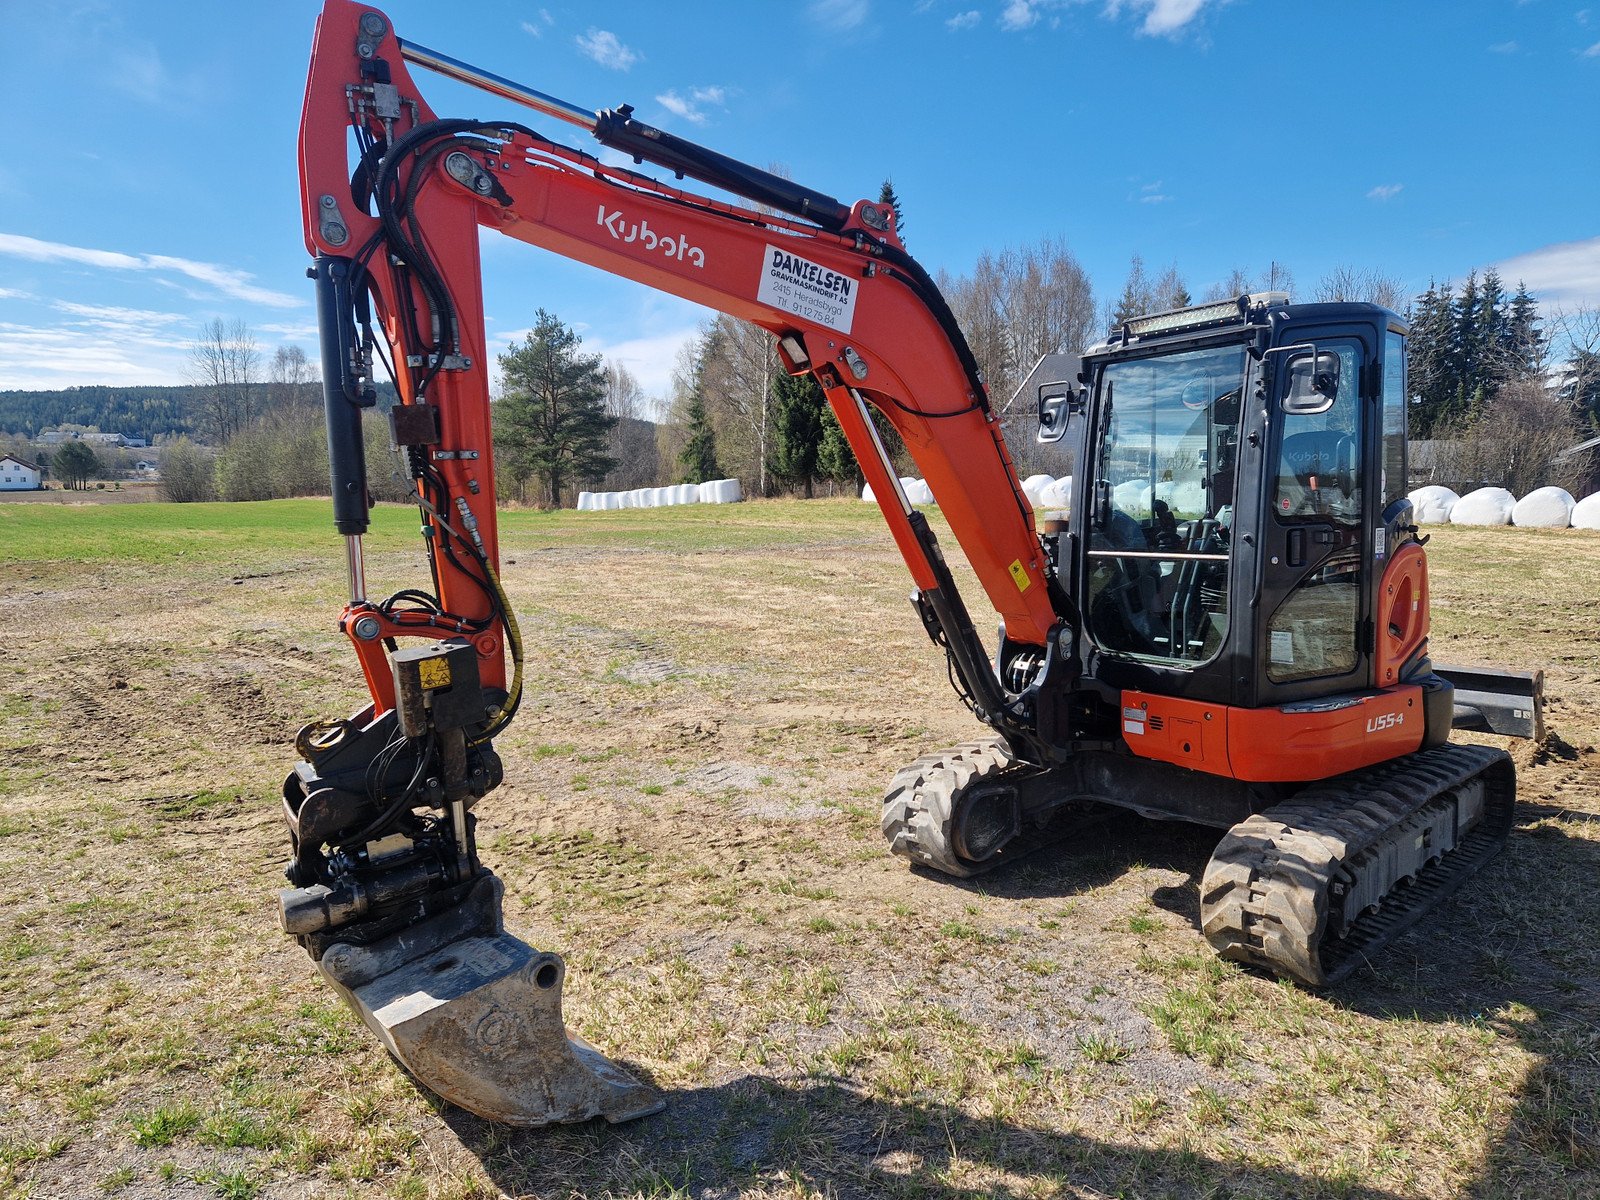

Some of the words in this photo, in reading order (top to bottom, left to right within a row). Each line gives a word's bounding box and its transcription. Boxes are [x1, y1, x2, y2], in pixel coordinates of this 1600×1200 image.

[597, 204, 705, 268] Kubota
[770, 269, 838, 301] GRAVEMASKINDRIFT
[838, 296, 848, 305] AS
[772, 250, 851, 296] DANIELSEN
[773, 281, 792, 296] 2415
[793, 289, 843, 316] Heradsbygd
[777, 296, 789, 309] Tlf.
[1288, 451, 1330, 462] Kubota
